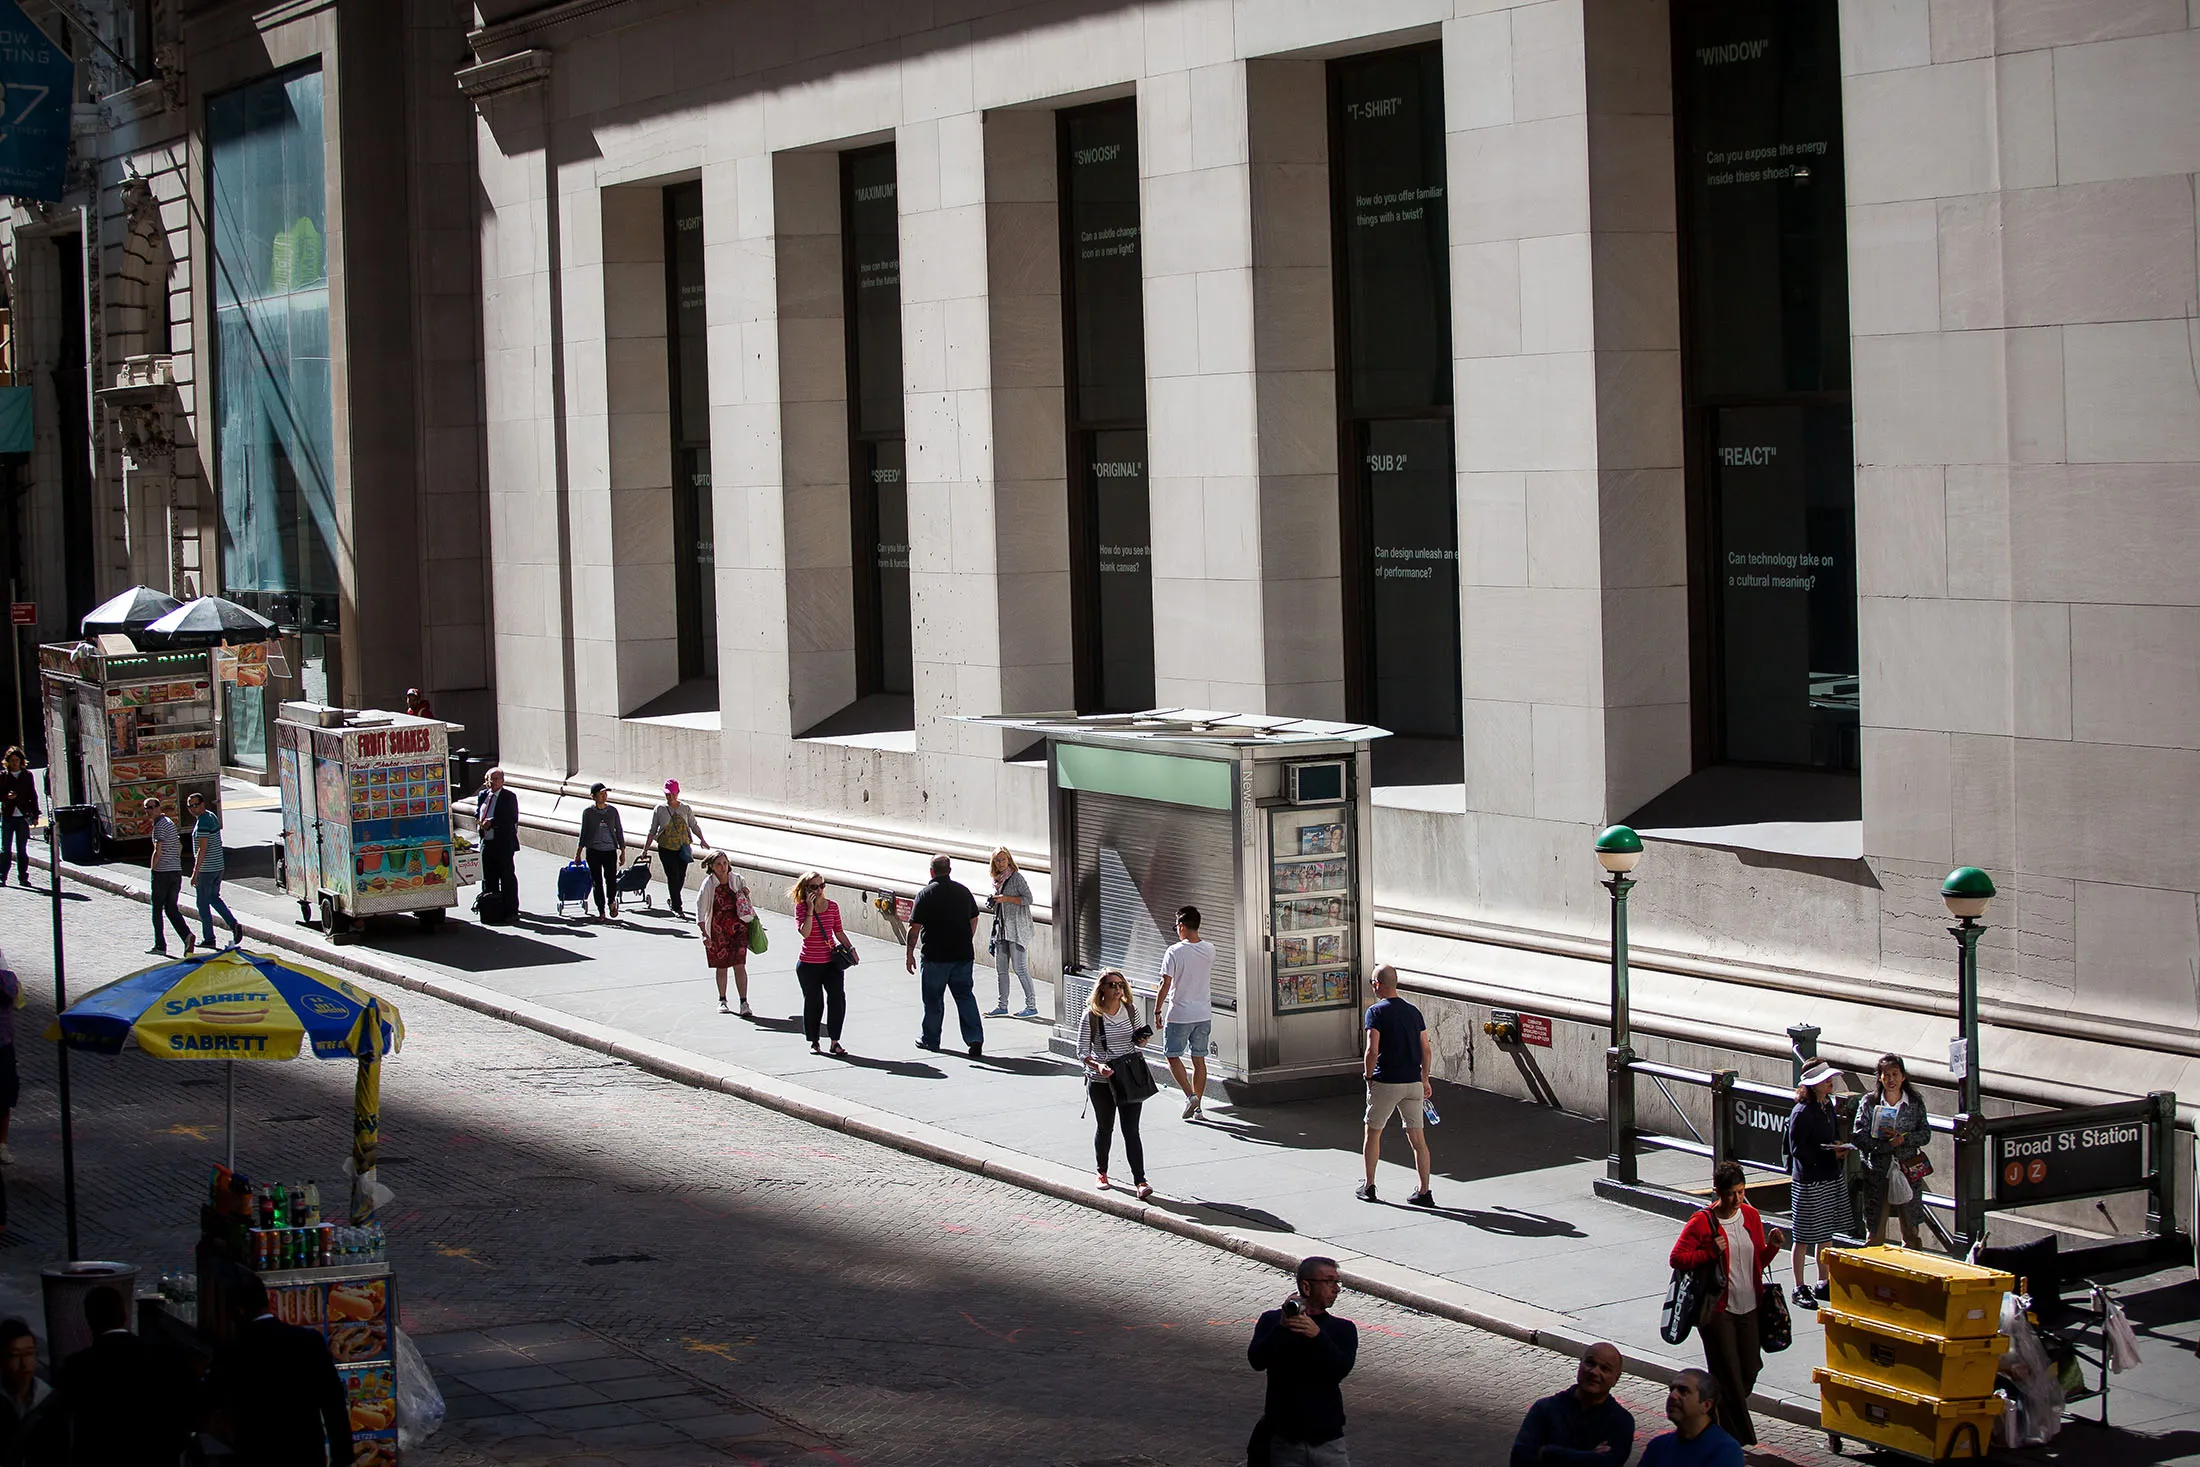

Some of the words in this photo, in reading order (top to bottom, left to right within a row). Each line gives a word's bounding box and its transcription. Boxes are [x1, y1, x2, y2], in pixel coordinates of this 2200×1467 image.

[0, 29, 29, 45] OW
[0, 48, 50, 65] TING
[1695, 38, 1768, 66] "WINDOW"
[1347, 97, 1402, 120] "T-SHIRT"
[1074, 144, 1120, 166] "SWOOSH"
[1706, 150, 1725, 164] Can
[1726, 150, 1743, 165] you
[1744, 146, 1777, 161] expose
[1779, 143, 1795, 157] the
[1796, 139, 1828, 155] energy
[1707, 172, 1733, 186] inside
[1735, 169, 1760, 183] these
[1762, 164, 1795, 180] shoes?
[855, 183, 897, 201] "MAXIMUM"
[1356, 194, 1372, 207] How
[1373, 193, 1383, 204] do
[1384, 192, 1397, 206] you
[1398, 188, 1415, 201] offer
[1416, 185, 1443, 200] familiar
[1357, 213, 1378, 227] things
[1379, 210, 1395, 223] with
[1395, 212, 1401, 221] a
[1401, 207, 1424, 221] twist?
[1116, 226, 1137, 238] change
[889, 258, 899, 271] orig
[1366, 454, 1393, 471] "SUB
[1395, 454, 1407, 471] 2"
[1718, 446, 1776, 466] "REACT"
[871, 469, 900, 482] "SPEED"
[1092, 462, 1141, 477] "ORIGINAL"
[692, 474, 711, 487] "UPTO
[1099, 544, 1112, 555] How
[1113, 545, 1121, 555] do
[1122, 546, 1132, 557] you
[1133, 547, 1144, 556] see
[1374, 546, 1389, 558] Can
[1390, 547, 1414, 561] design
[1414, 547, 1442, 560] unleash
[1444, 550, 1453, 560] an
[1100, 561, 1116, 572] blank
[1728, 551, 1746, 565] Can
[1747, 552, 1798, 569] technology
[1799, 553, 1819, 567] take
[1821, 555, 1834, 567] on
[1375, 565, 1382, 576] of
[1384, 566, 1432, 579] performance?
[1728, 575, 1734, 586] a
[1736, 573, 1769, 587] cultural
[1772, 574, 1816, 591] meaning?
[357, 731, 387, 758] FRUIT
[388, 728, 431, 755] SHAKES
[1242, 771, 1254, 848] Newsstand
[163, 992, 269, 1016] SABRETT
[169, 1034, 269, 1052] SABRETT
[1735, 1100, 1790, 1133] Subwa
[2004, 1135, 2052, 1158] Broad
[2057, 1133, 2076, 1151] St
[2082, 1126, 2138, 1148] Station
[2009, 1167, 2019, 1181] J
[2031, 1164, 2041, 1178] Z
